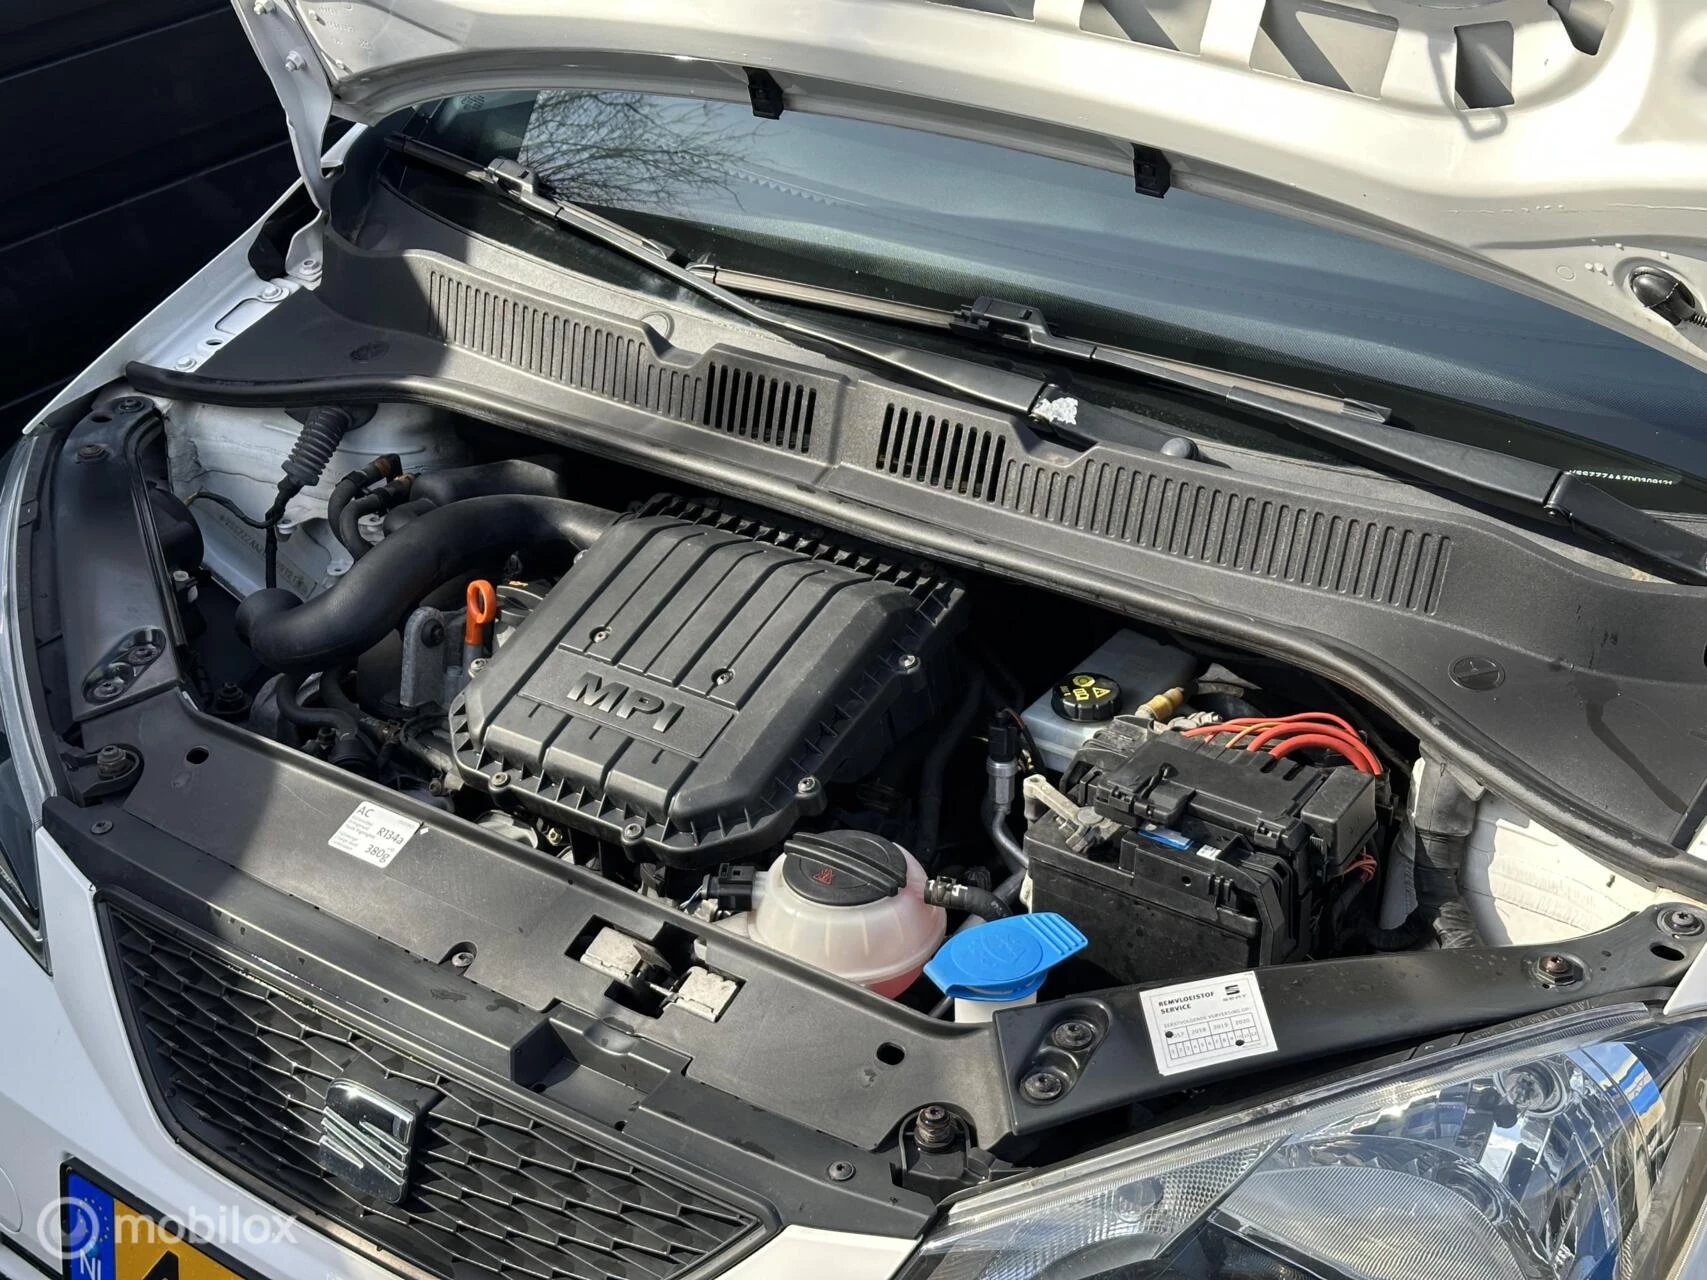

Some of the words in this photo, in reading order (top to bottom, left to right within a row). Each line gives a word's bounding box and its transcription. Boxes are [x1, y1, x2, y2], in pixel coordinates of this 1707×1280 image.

[566, 671, 685, 733] MPI
[356, 806, 375, 818] AC
[376, 827, 405, 845] R134a
[364, 844, 390, 863] 380g
[1158, 991, 1215, 1007] REMVLOEISTOF
[1160, 1003, 1192, 1014] SERVICE
